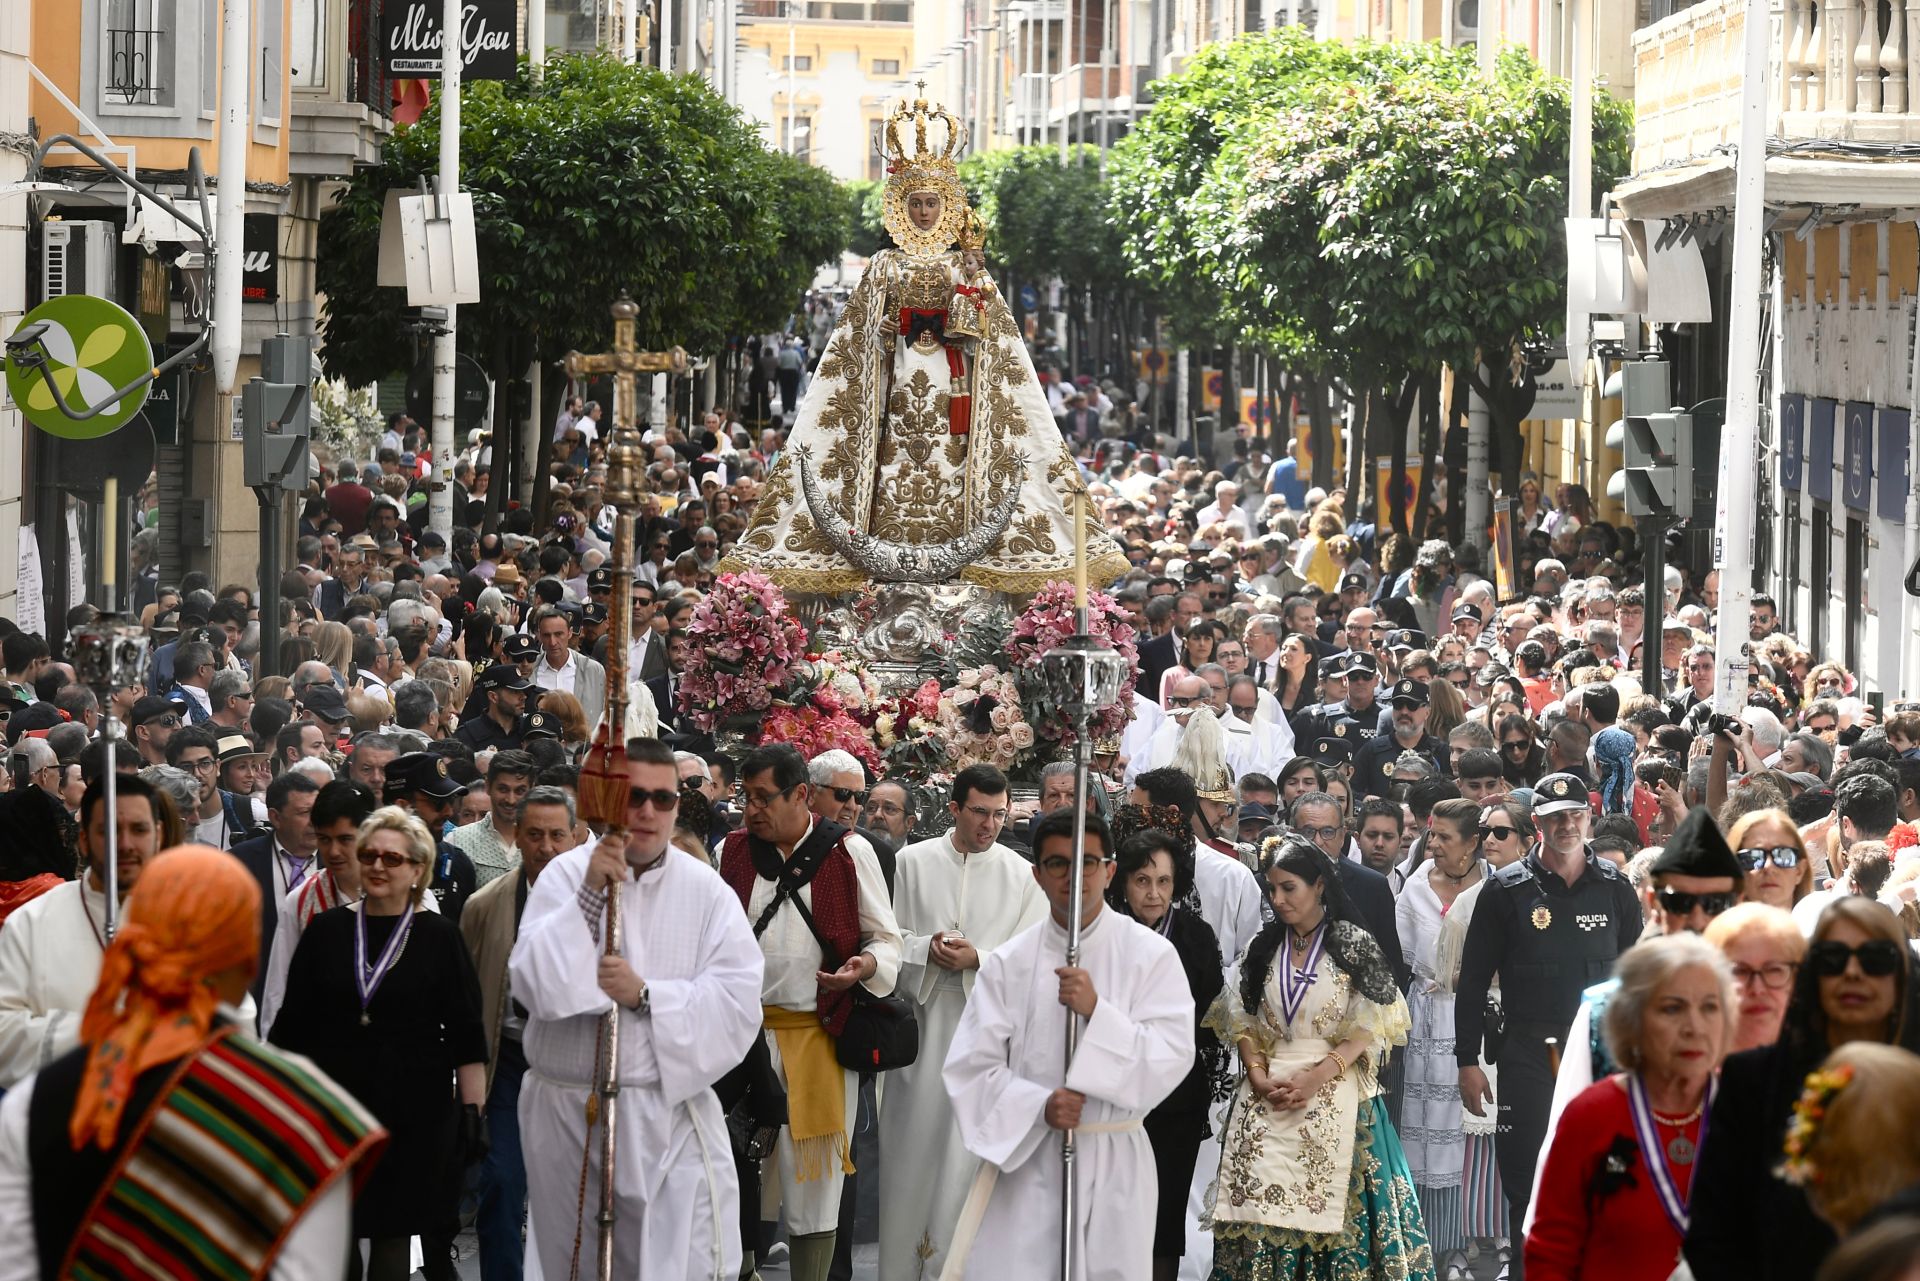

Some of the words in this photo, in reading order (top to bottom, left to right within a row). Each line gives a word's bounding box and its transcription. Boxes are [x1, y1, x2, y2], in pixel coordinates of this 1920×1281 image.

[391, 3, 443, 51] Mis
[461, 4, 510, 65] You
[393, 61, 433, 69] RESTAURANTE
[1575, 914, 1609, 923] POLICIA
